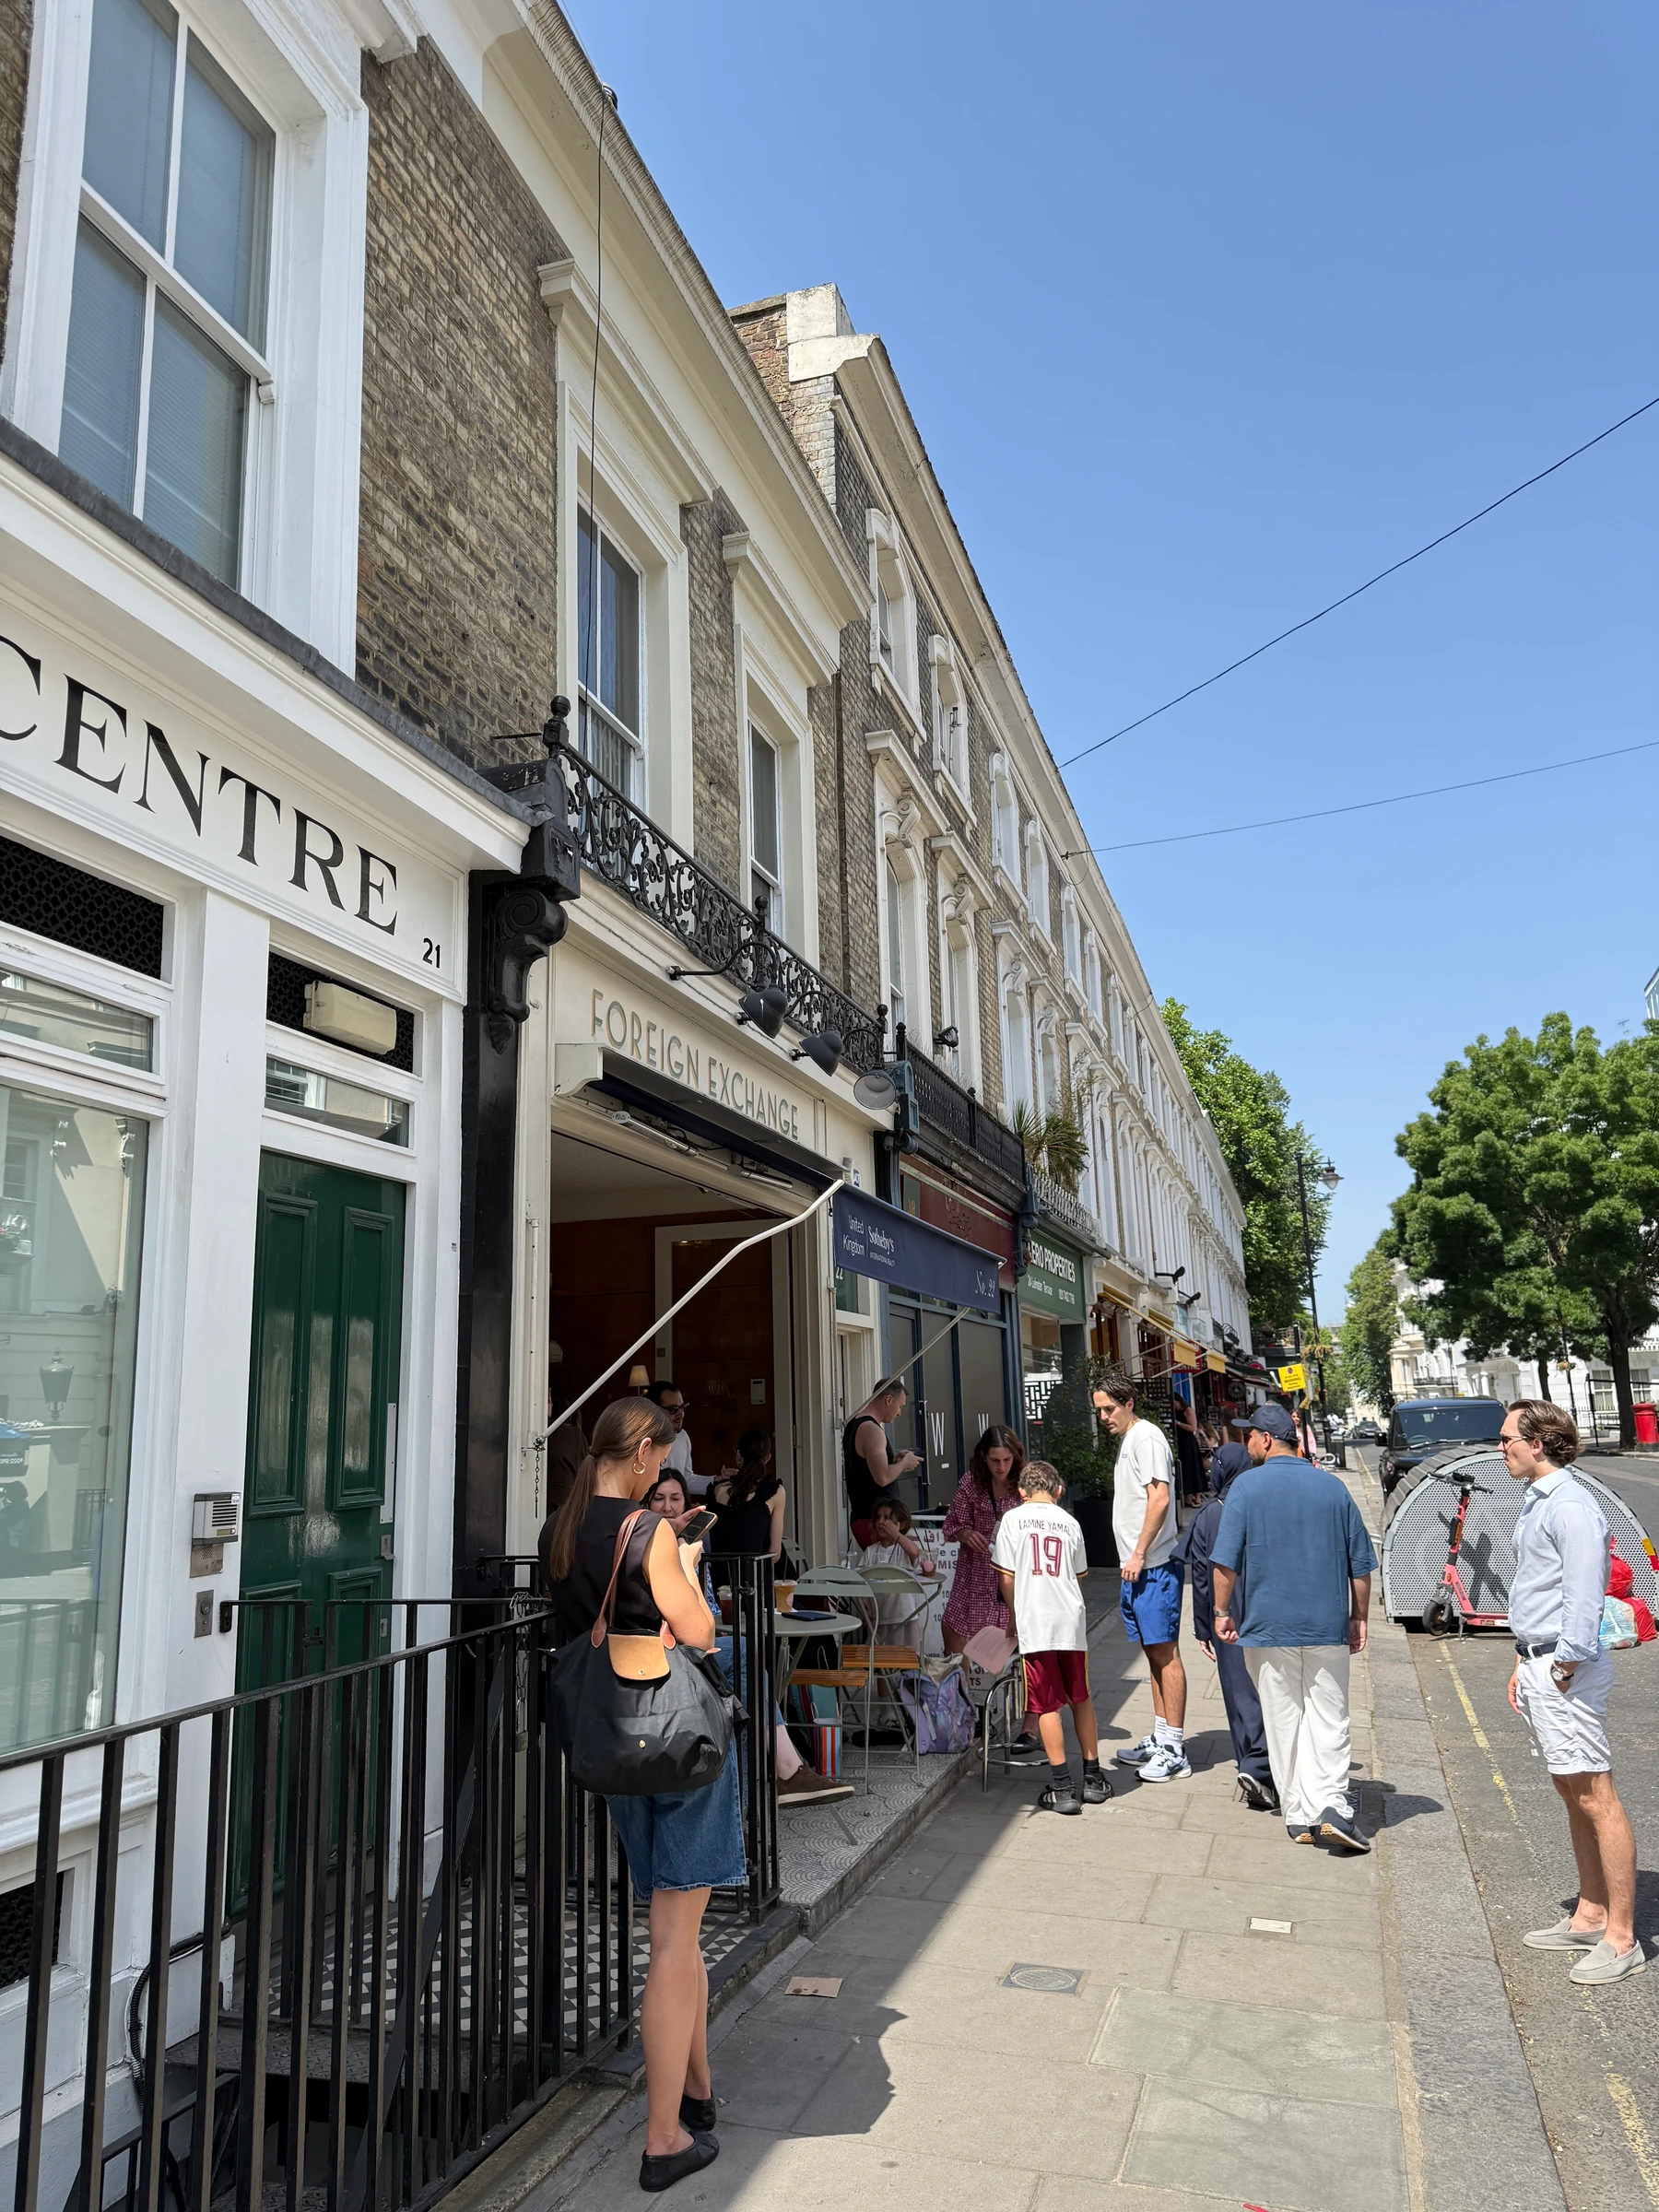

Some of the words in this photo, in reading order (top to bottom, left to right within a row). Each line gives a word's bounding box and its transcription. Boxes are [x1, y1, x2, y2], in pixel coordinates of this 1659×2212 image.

[422, 937, 441, 969] 21
[590, 988, 700, 1089] FOREIGN
[707, 1055, 799, 1141] EXCHANGE
[848, 1214, 865, 1234] United
[842, 1233, 865, 1256] Kingdom
[867, 1225, 895, 1254] Sotheby's
[1044, 1247, 1076, 1284] PROPERTIES
[1018, 1519, 1045, 1530] LAMINE
[1047, 1521, 1071, 1536] YAMAL
[1030, 1533, 1063, 1578] 19
